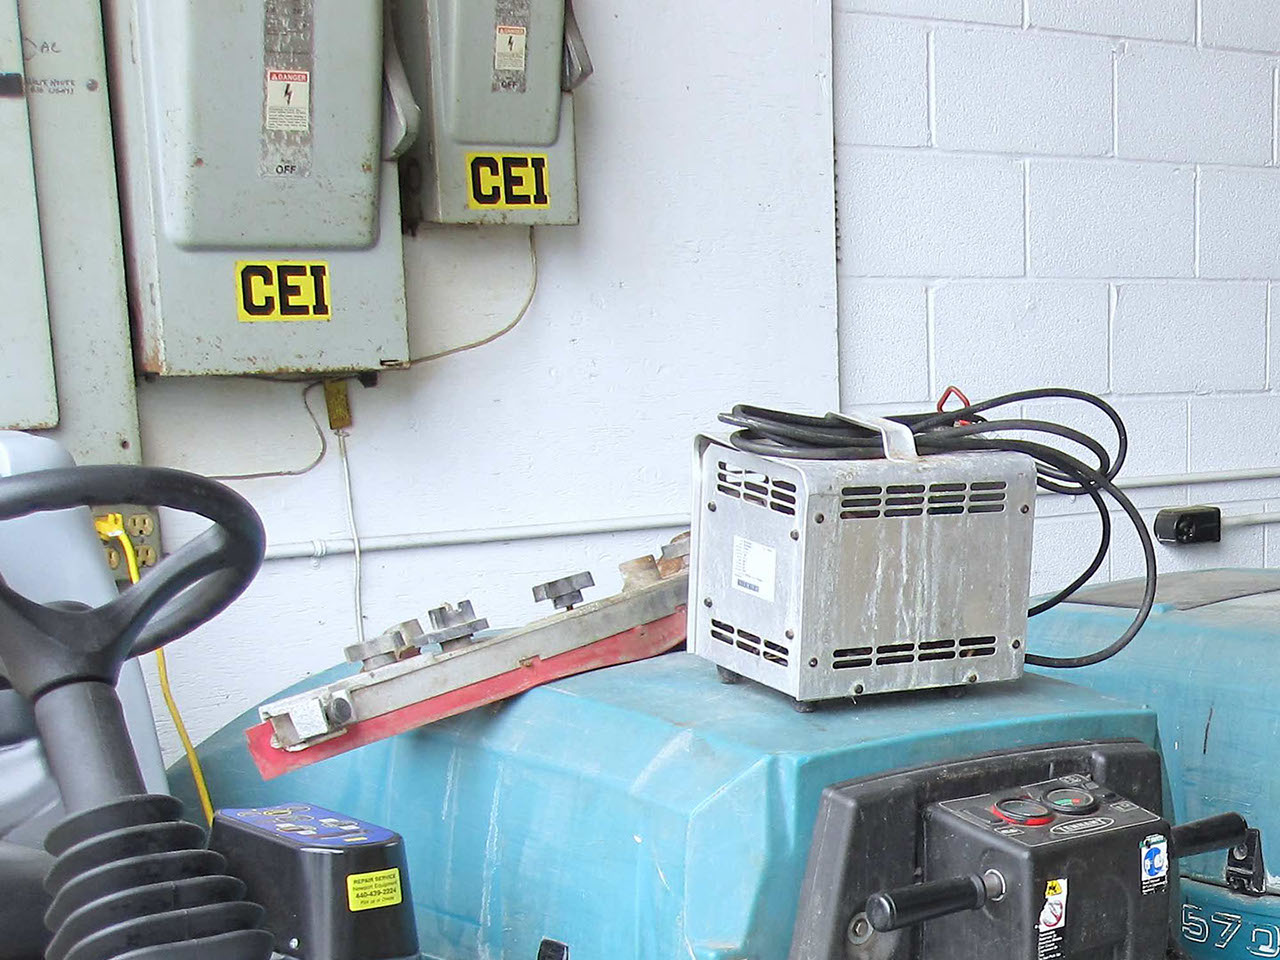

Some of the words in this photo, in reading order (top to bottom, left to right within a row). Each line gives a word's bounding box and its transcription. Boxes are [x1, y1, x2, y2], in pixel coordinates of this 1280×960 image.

[278, 73, 307, 81] DANGER
[501, 81, 518, 89] OFF
[275, 165, 297, 175] OFF
[470, 156, 548, 205] CEI
[240, 264, 329, 316] CEI
